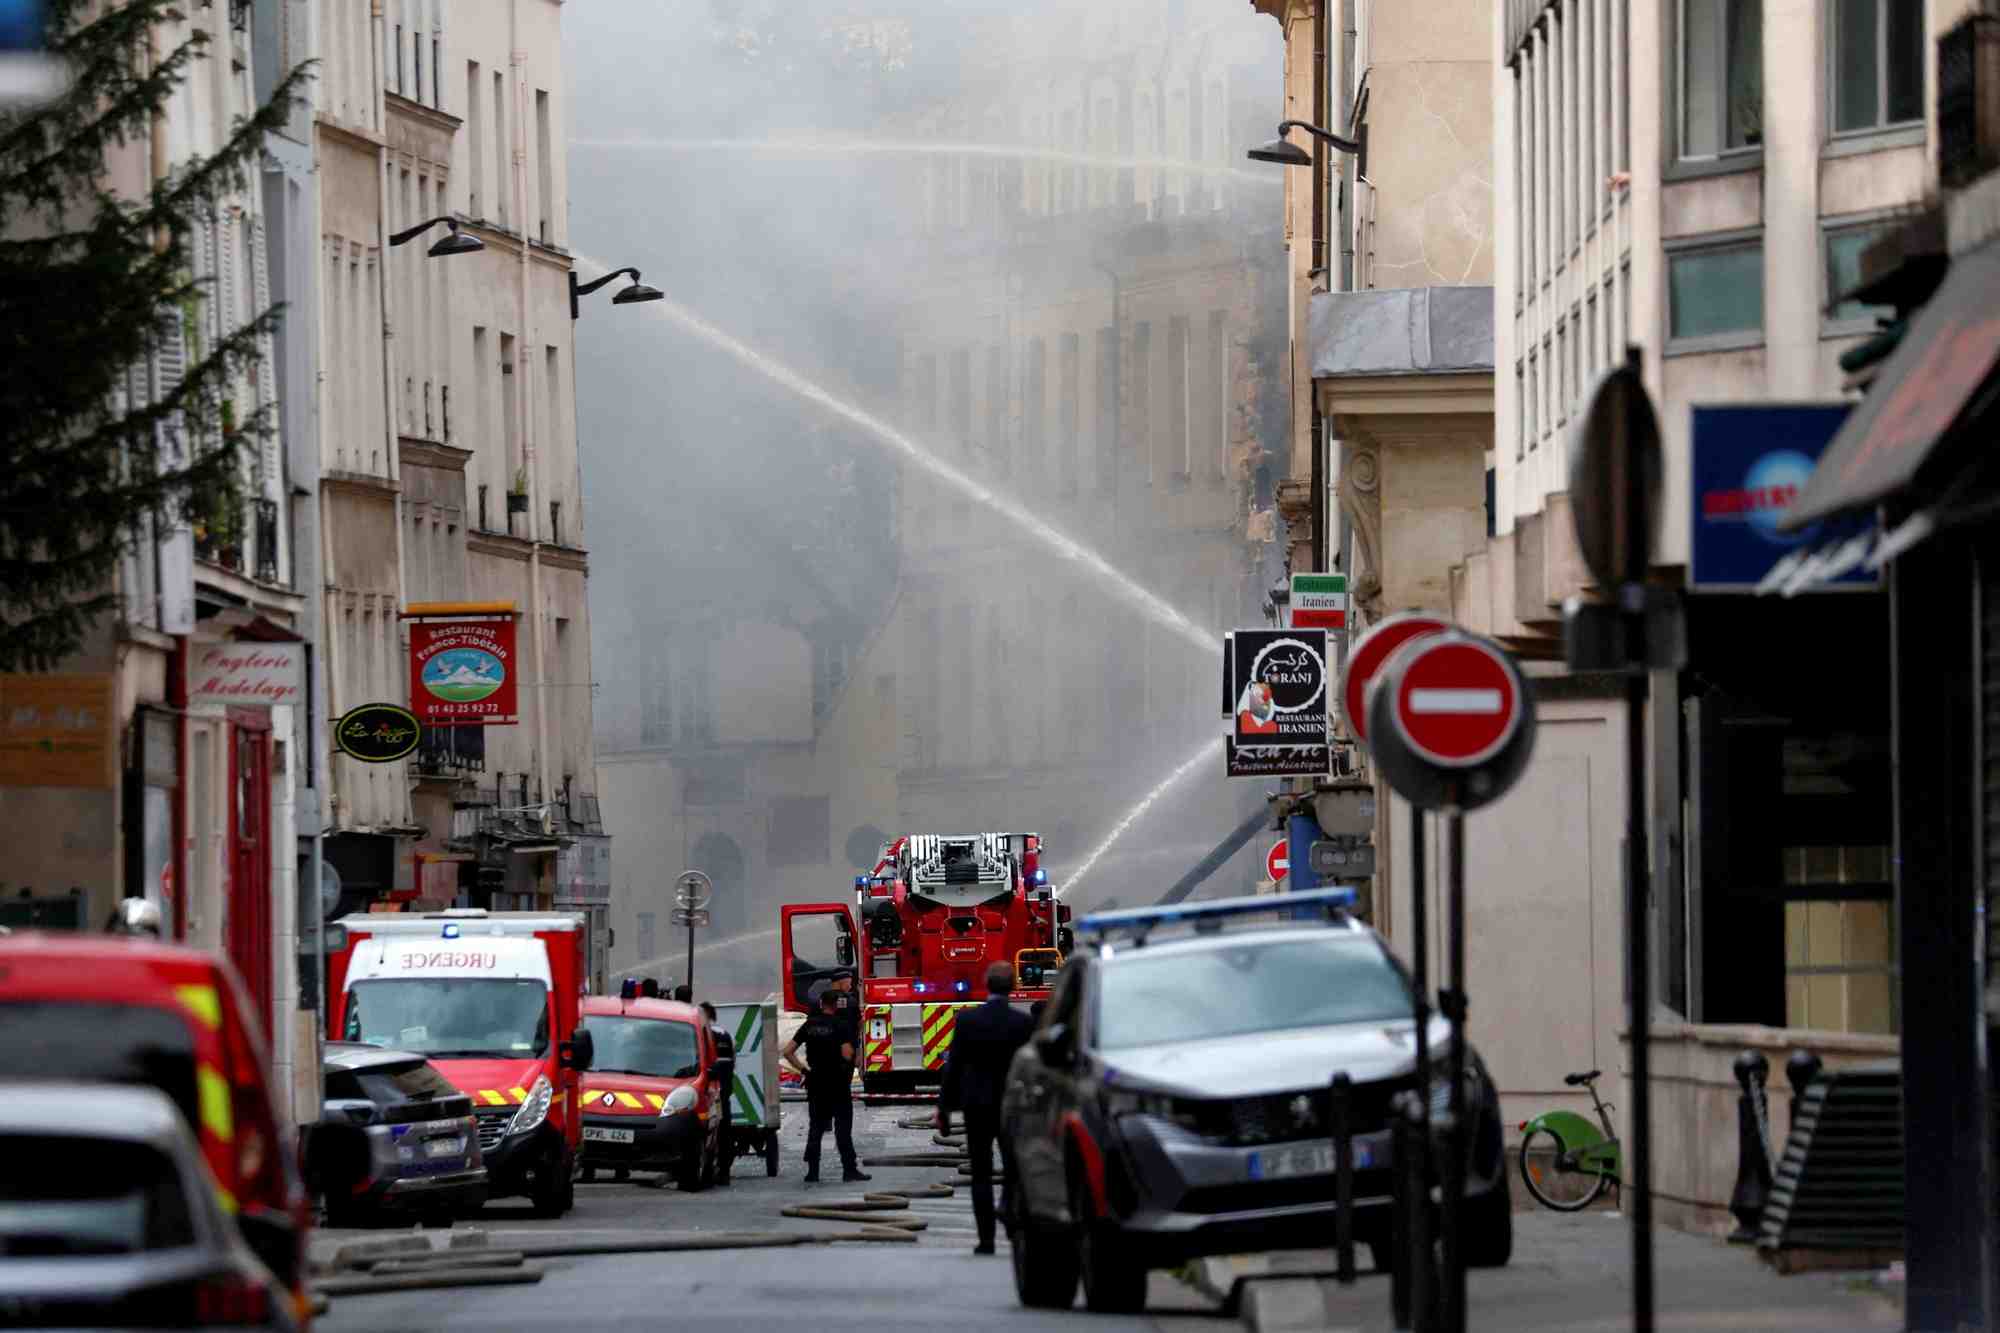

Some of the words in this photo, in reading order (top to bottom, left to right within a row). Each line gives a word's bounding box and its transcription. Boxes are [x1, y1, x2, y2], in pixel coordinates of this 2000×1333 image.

[1303, 595, 1335, 608] Iranien
[430, 625, 496, 639] Restaurant
[427, 704, 439, 713] 01
[457, 704, 468, 713] 25
[486, 703, 498, 713] 72
[1276, 714, 1327, 722] RESTAURANT
[1279, 723, 1326, 733] IRANIEN
